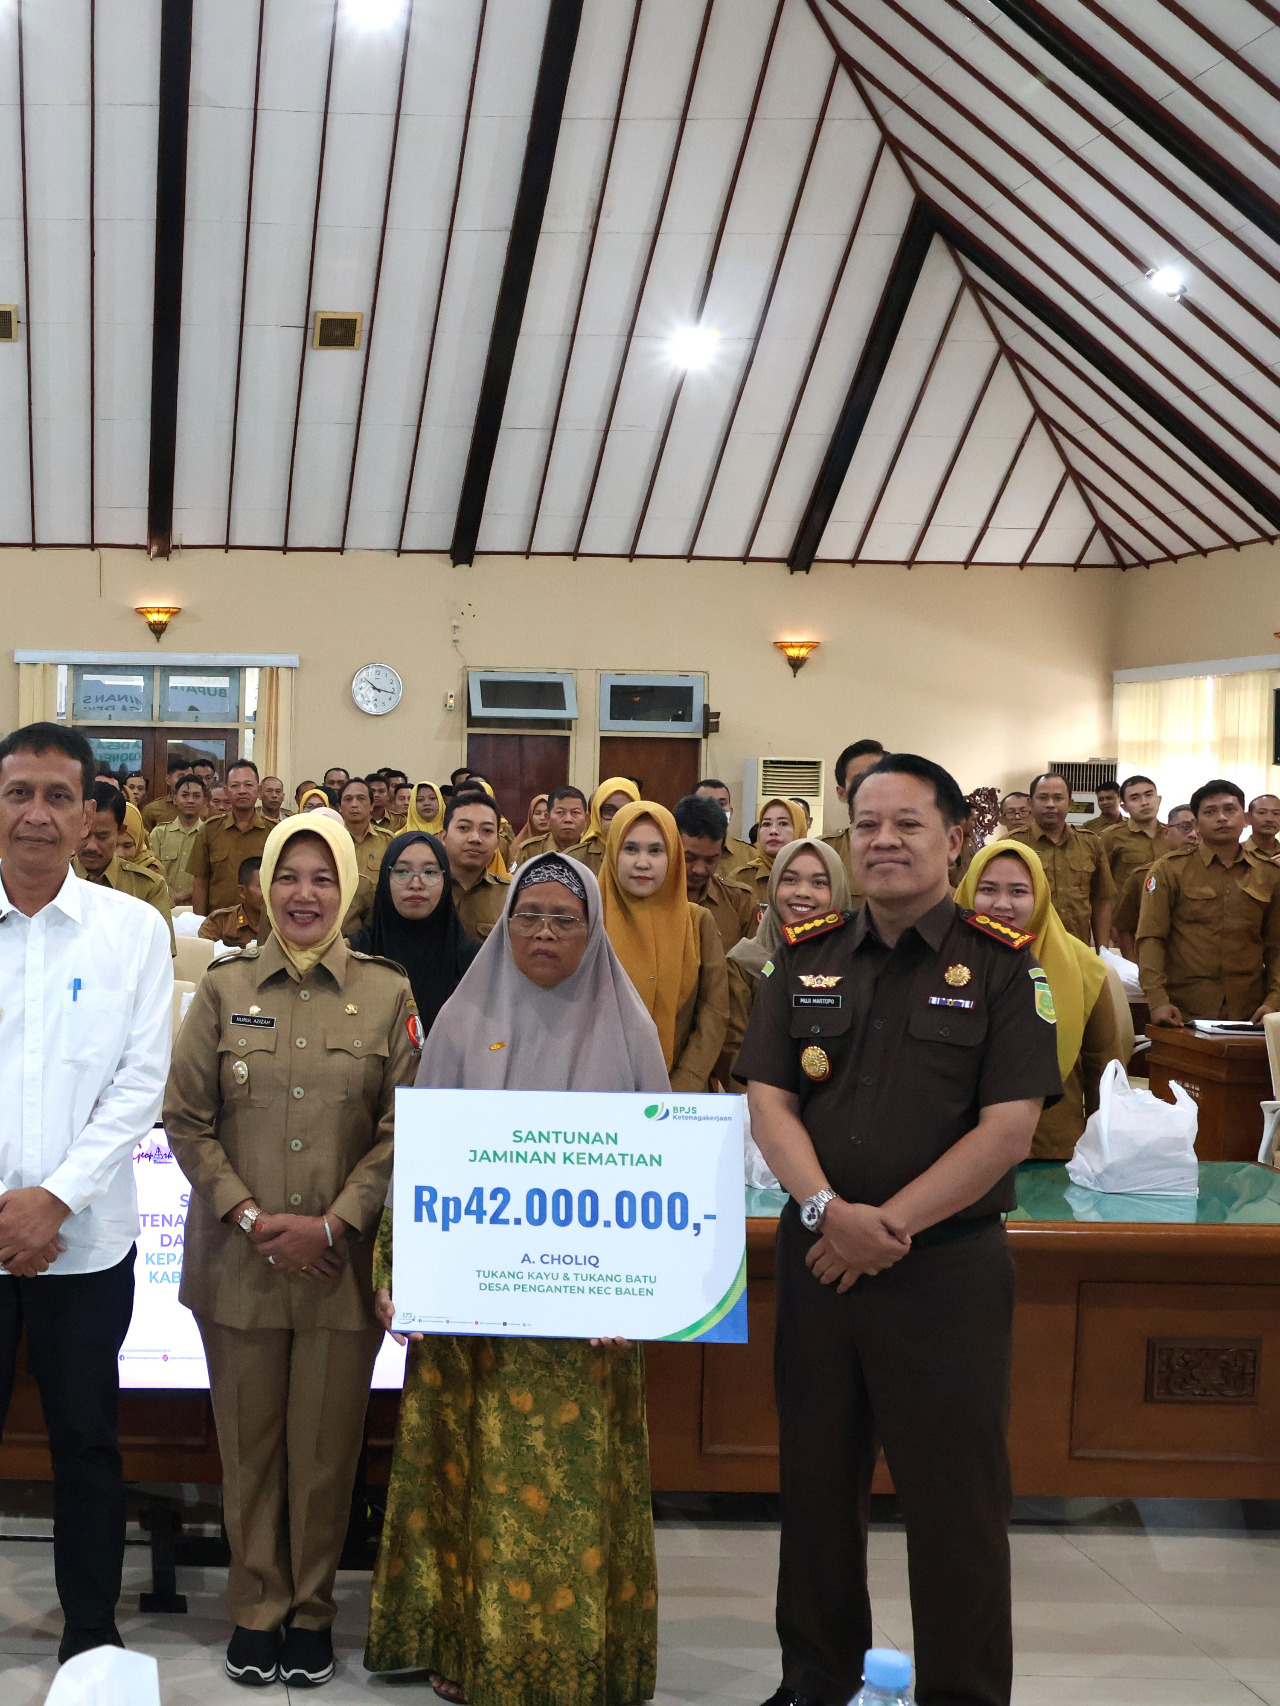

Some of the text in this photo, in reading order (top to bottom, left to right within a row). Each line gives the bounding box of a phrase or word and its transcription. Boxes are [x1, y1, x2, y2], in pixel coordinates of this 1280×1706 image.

[513, 1130, 617, 1145] SANTUNAN
[469, 1150, 661, 1167] JAMINAN KEMATIAN
[414, 1185, 716, 1236] Rp42.000.000,-
[521, 1254, 599, 1268] A. CHOLIQ
[476, 1270, 656, 1283] TUKANG KAYU & TUKANG BATU
[480, 1283, 653, 1296] DESA PENGANTEN KEC BALEN
